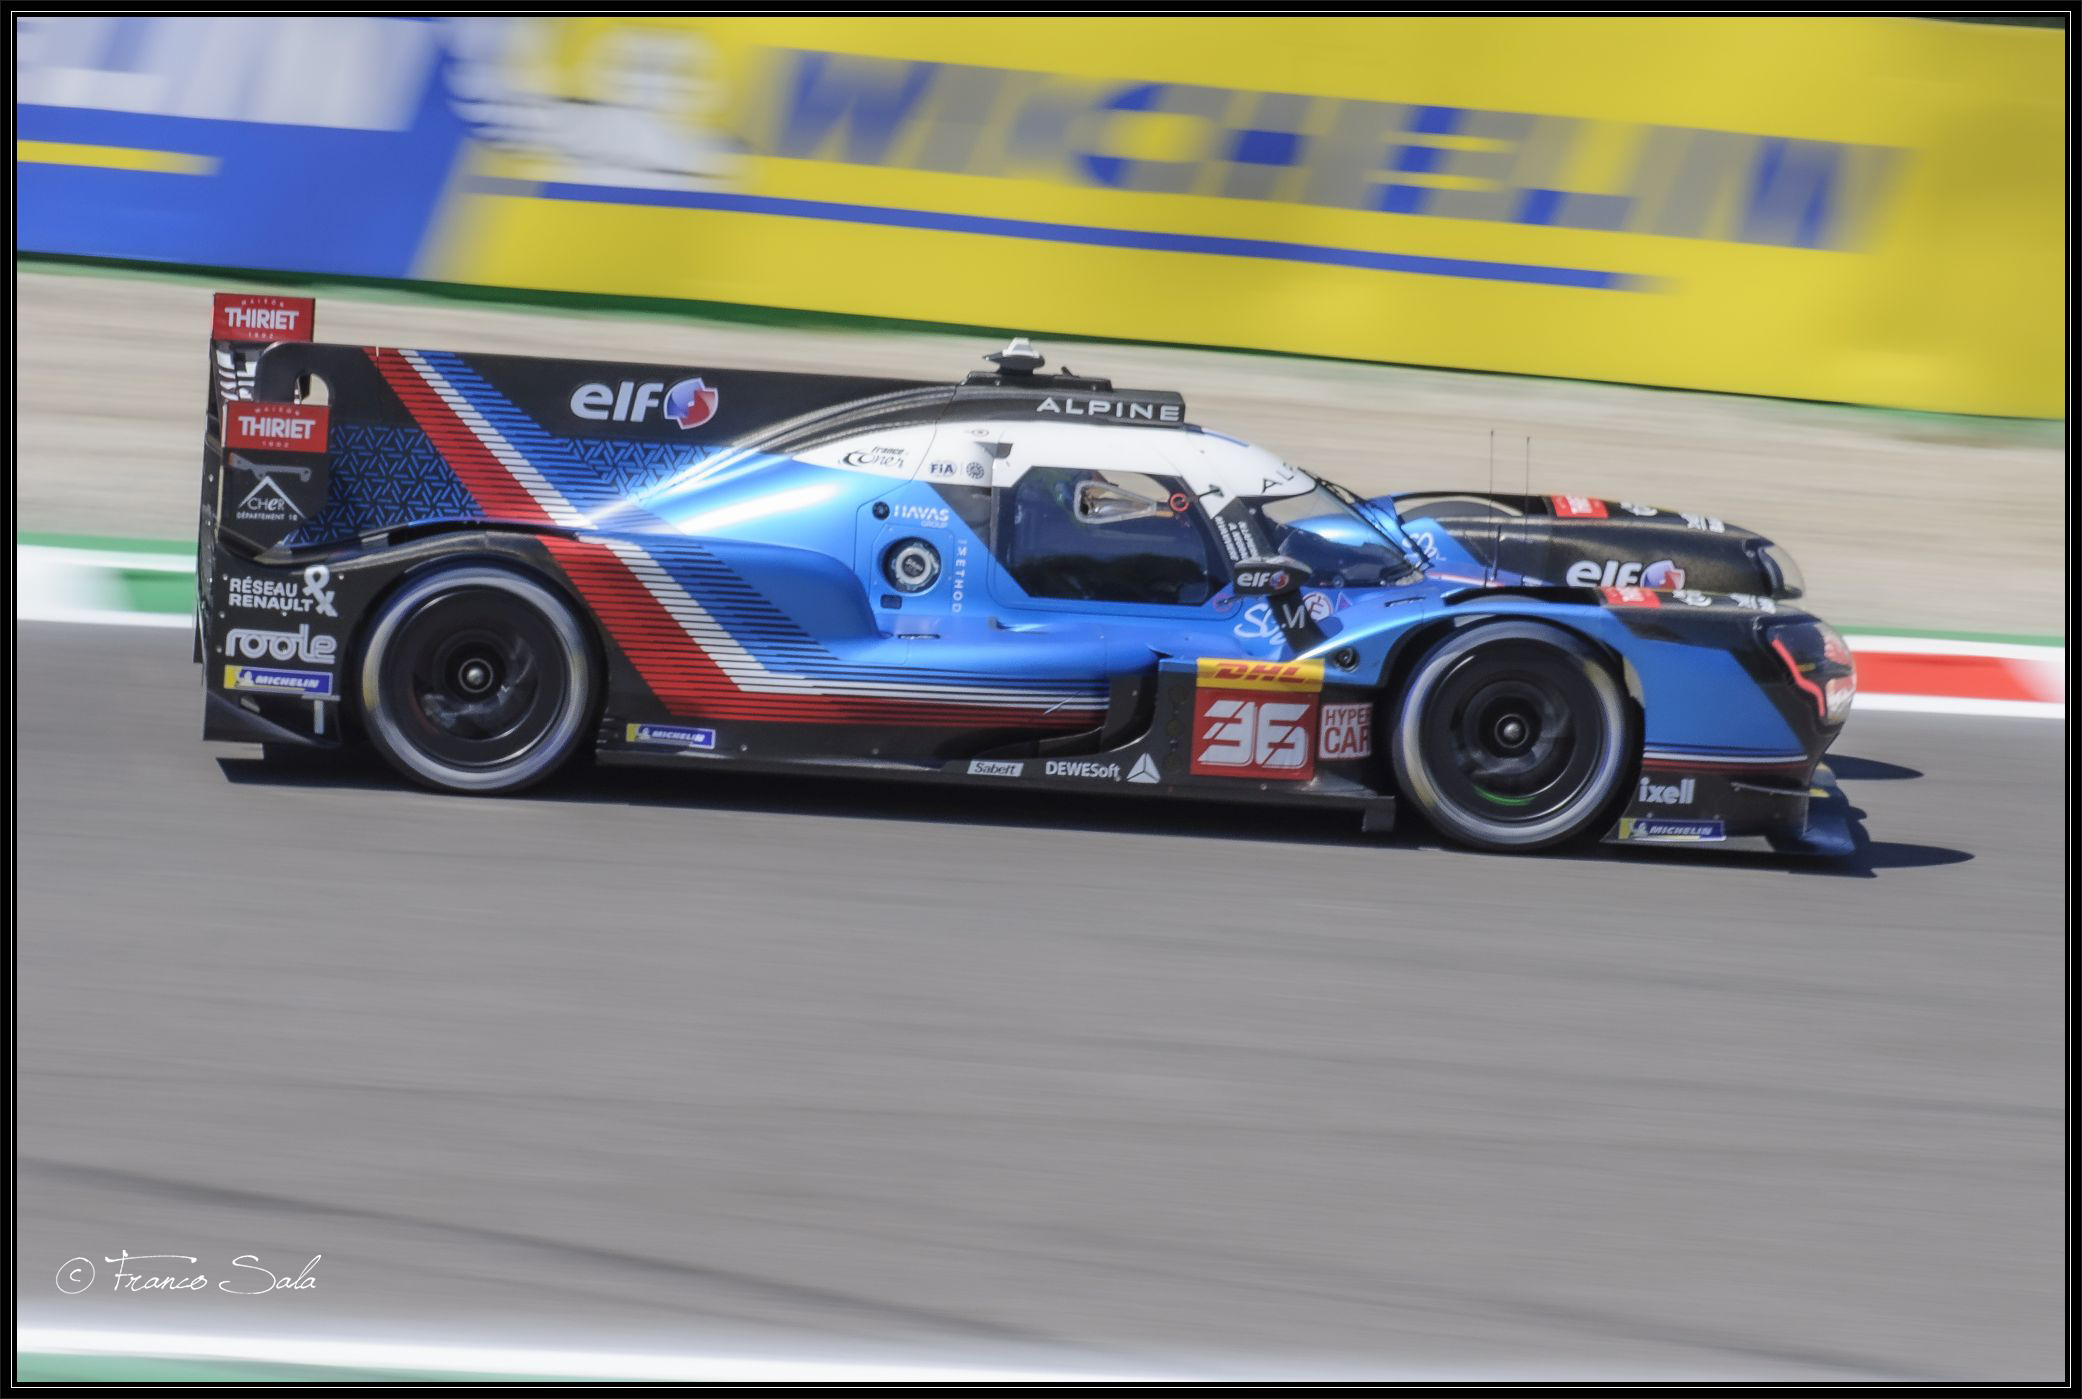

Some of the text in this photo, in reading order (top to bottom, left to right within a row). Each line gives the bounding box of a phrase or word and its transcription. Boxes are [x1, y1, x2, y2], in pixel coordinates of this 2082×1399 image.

[224, 306, 300, 331] THIRIET
[570, 380, 664, 423] elf
[1036, 396, 1180, 421] ALPINE
[237, 415, 317, 440] THIRIET
[893, 503, 950, 521] HAVAS
[1237, 572, 1271, 588] elf
[1566, 559, 1643, 588] elf
[229, 576, 298, 597] RÉSEAU
[228, 593, 314, 613] RENAULT
[225, 624, 337, 664] roole
[255, 675, 320, 689] MICHELIN
[1214, 662, 1305, 684] DHL
[652, 730, 706, 743] MICHELIN
[1197, 700, 1309, 770] 36
[974, 761, 1016, 776] Sabelt
[1045, 761, 1121, 779] DEWESoft
[1639, 776, 1695, 805] ixell
[1649, 824, 1714, 836] MICHELIN
